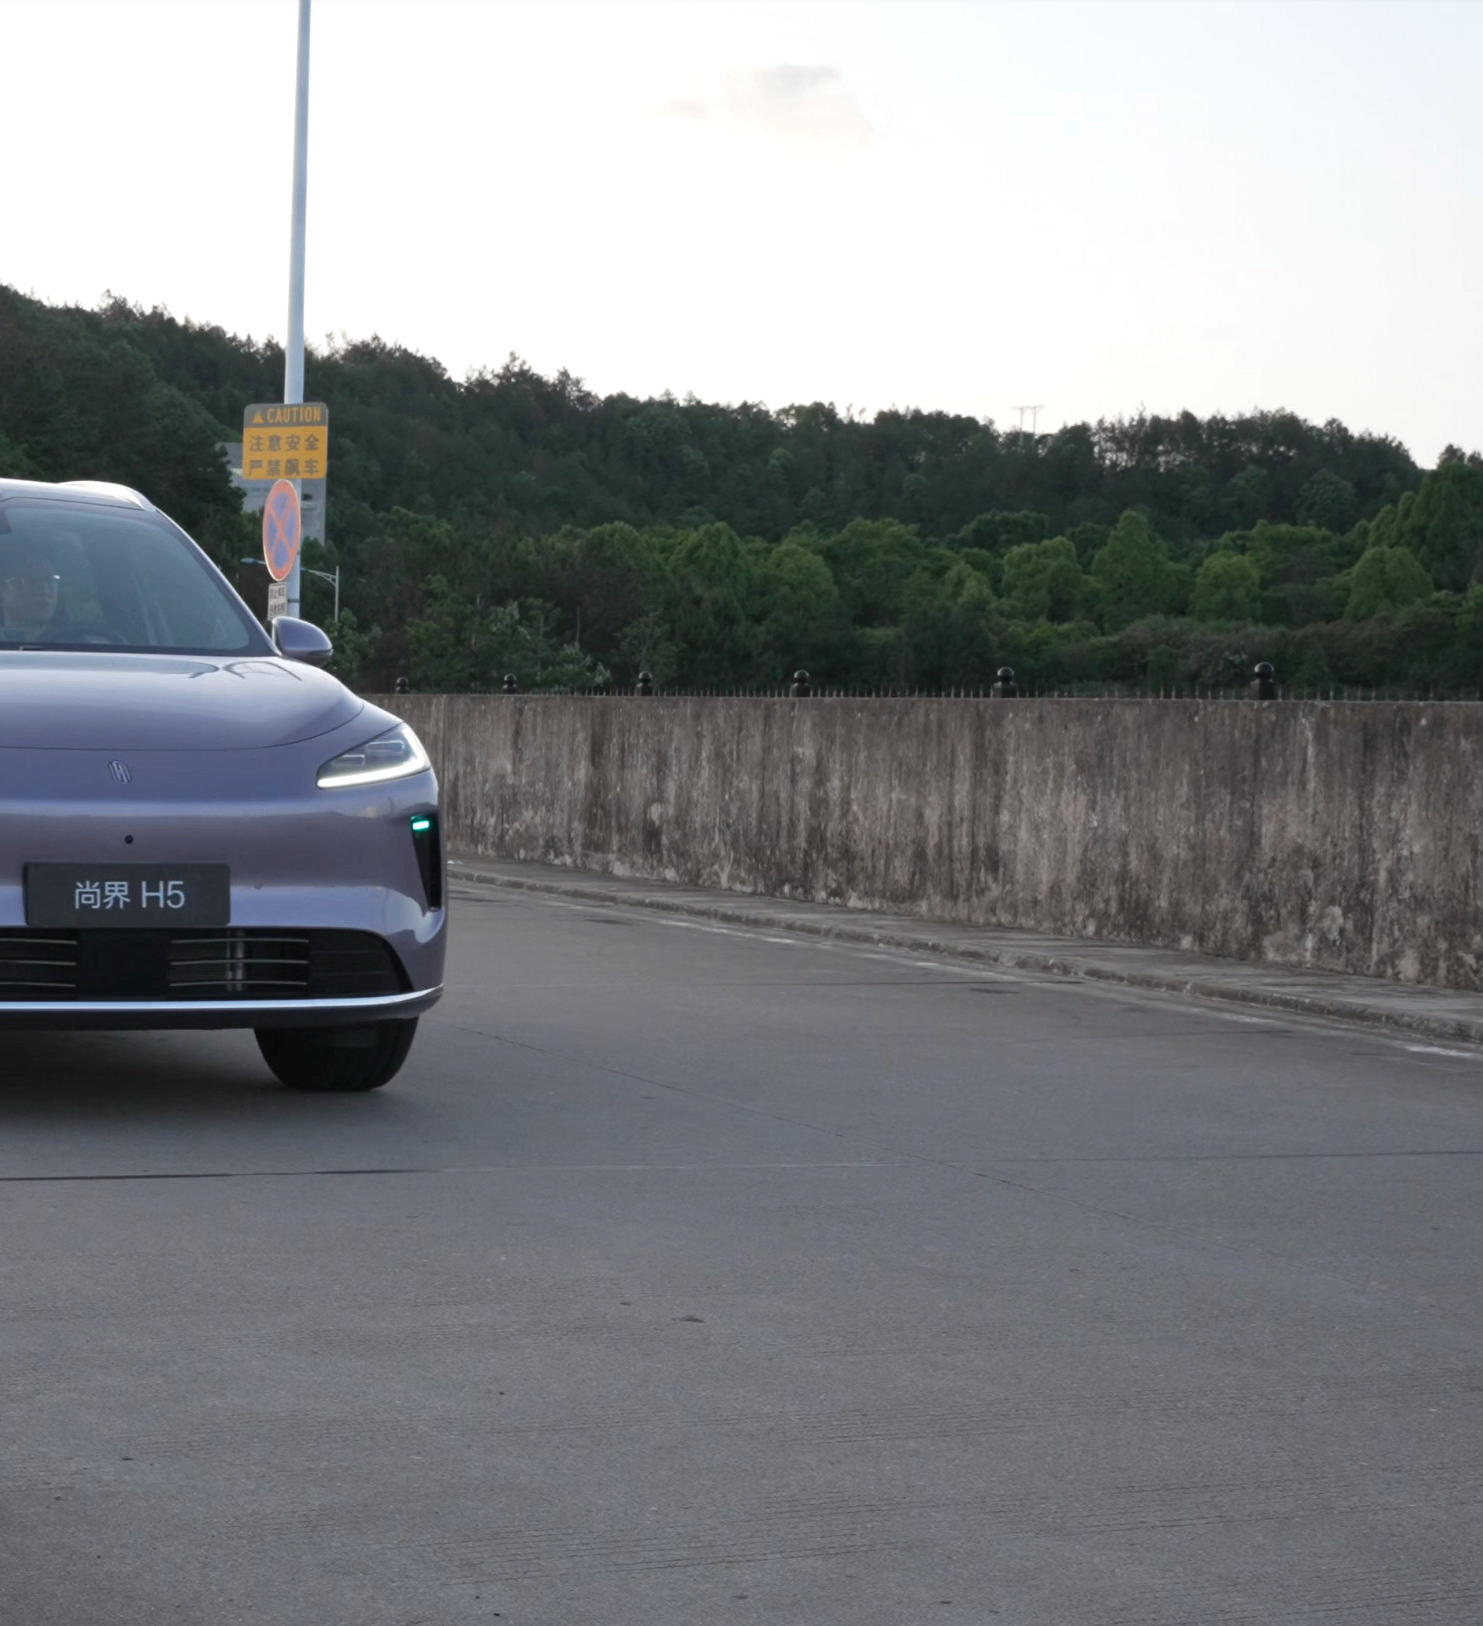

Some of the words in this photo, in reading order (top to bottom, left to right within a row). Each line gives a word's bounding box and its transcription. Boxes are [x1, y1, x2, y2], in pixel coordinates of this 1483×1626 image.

[267, 406, 322, 423] CAUTION
[249, 433, 319, 452] 注意安全
[74, 880, 131, 910] 尚界
[141, 880, 185, 909] H5
